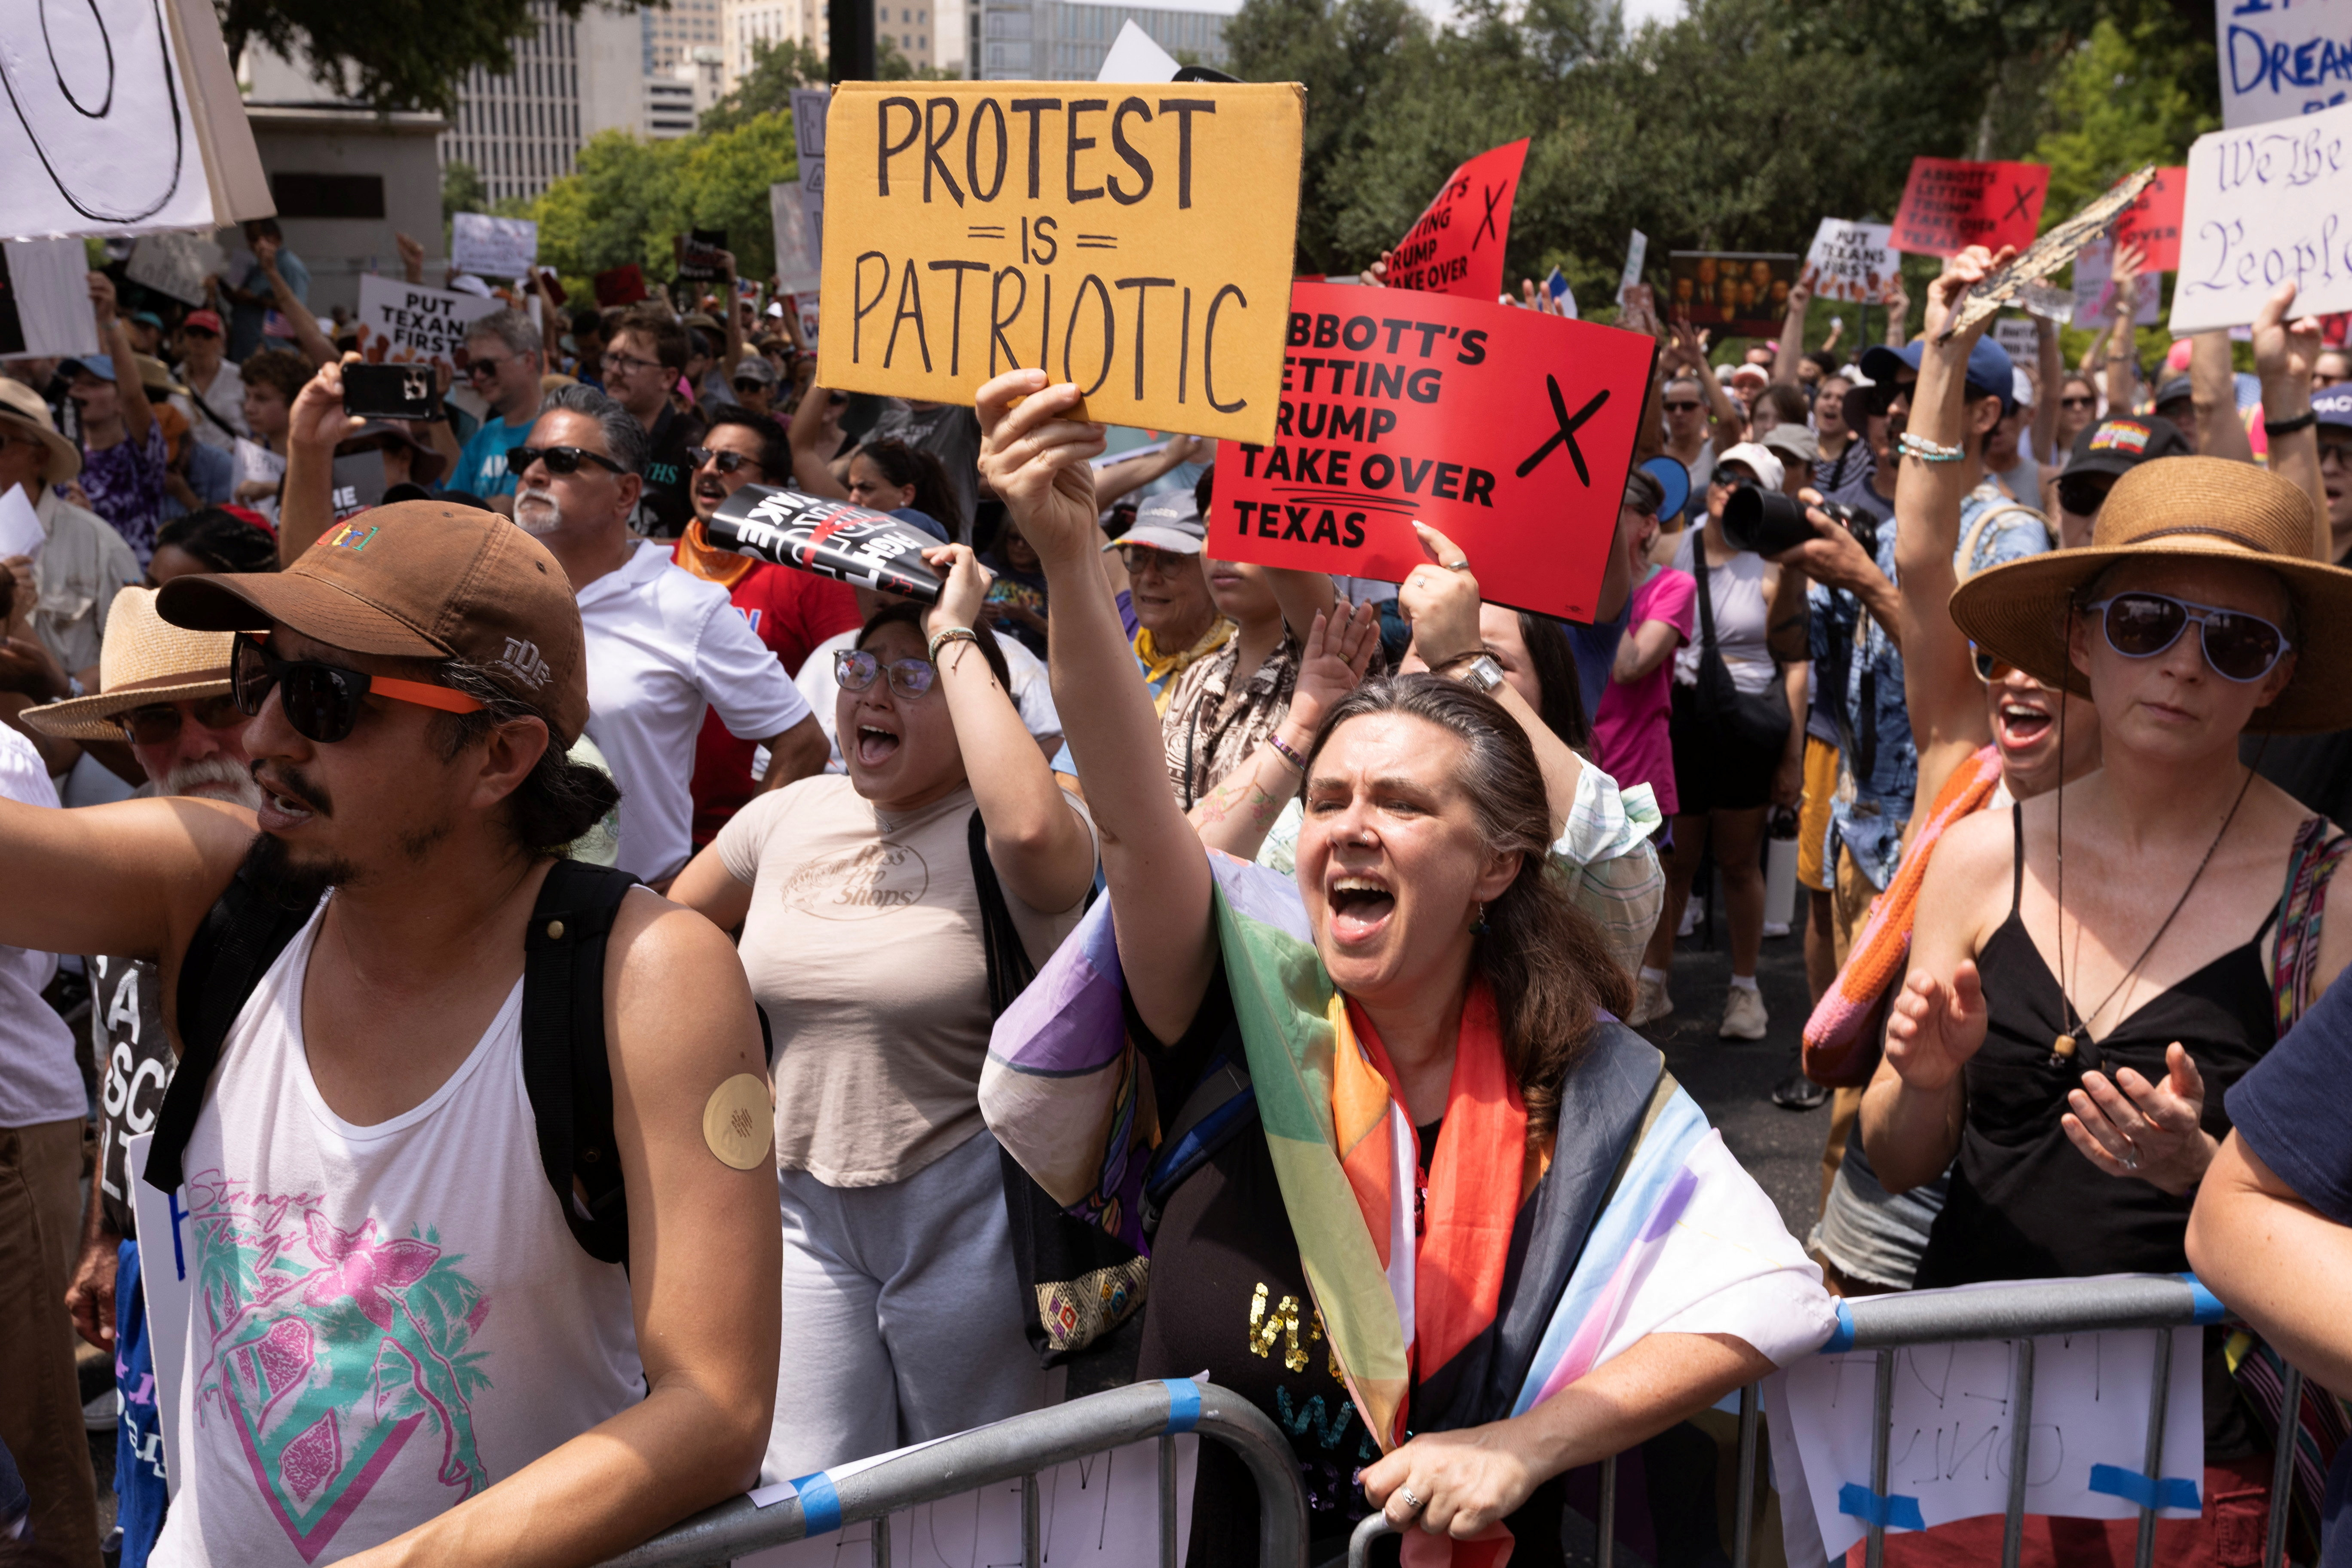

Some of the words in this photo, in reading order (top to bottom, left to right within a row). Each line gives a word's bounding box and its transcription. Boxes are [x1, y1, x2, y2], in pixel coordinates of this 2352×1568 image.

[878, 96, 1216, 209] PROTEST
[2215, 138, 2272, 192] We
[2260, 128, 2343, 188] The
[1021, 216, 1058, 264] IS
[1837, 231, 1868, 245] PUT
[1428, 256, 1467, 288] OVER
[407, 292, 455, 315] PUT
[394, 328, 460, 353] FIRST
[853, 250, 1247, 412] PATRIOTIC
[1240, 442, 1351, 487] TAKE
[1360, 453, 1494, 508] OVER
[317, 522, 379, 551] Ctrl
[736, 491, 823, 548] TAKE
[1233, 500, 1367, 548] TEXAS
[845, 531, 923, 591] FIGHT
[833, 886, 913, 910] Shops
[845, 867, 886, 885] Pro
[194, 1213, 304, 1273] Things
